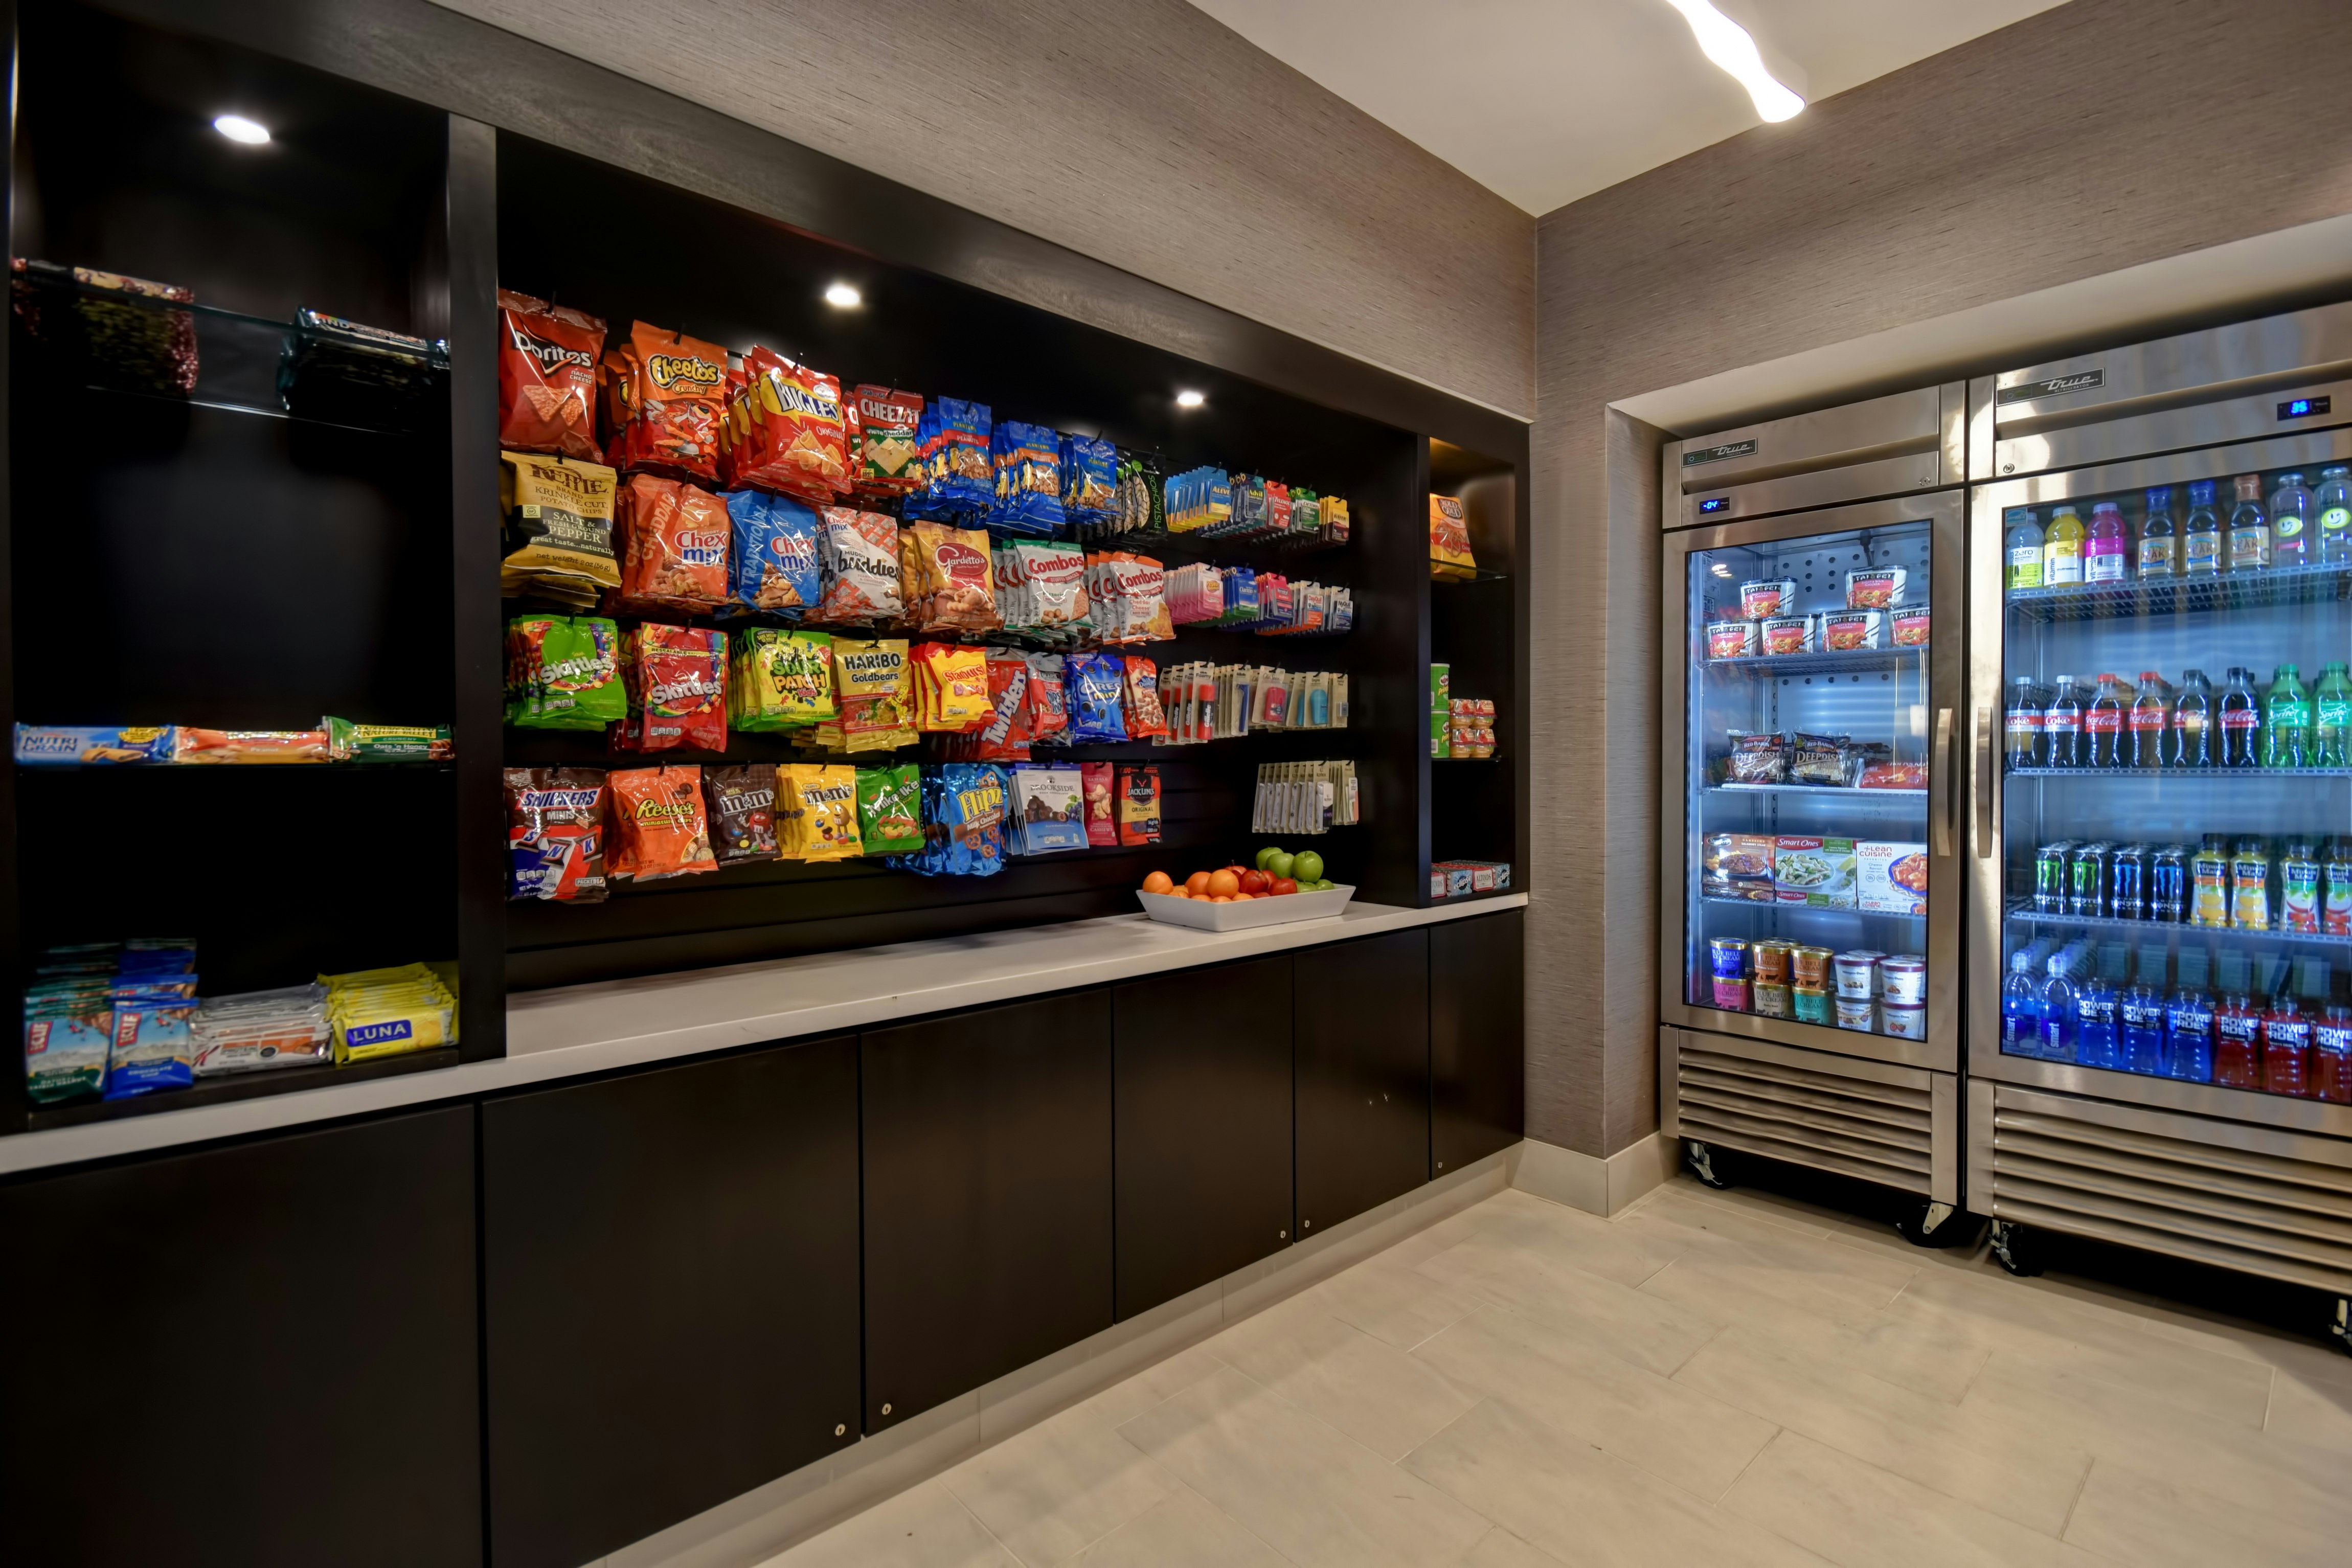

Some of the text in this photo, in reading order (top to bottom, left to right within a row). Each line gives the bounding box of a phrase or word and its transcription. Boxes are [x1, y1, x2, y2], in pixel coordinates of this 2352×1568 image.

[515, 331, 592, 367] Doritos
[571, 371, 592, 379] NACHO
[650, 355, 718, 387] Cheetos
[570, 375, 592, 384] CHEESE
[672, 384, 707, 394] Crunchy
[2054, 382, 2091, 393] REFRIGERATOR
[766, 374, 839, 422] BUGLES
[816, 426, 844, 440] ORIGINAL
[957, 435, 979, 444] PEANUTS
[535, 486, 582, 506] KRINKLE
[556, 485, 583, 499] BRAND
[1213, 486, 1230, 495] ALEVE
[1249, 489, 1263, 497] Advil
[541, 496, 574, 509] POTATO
[1148, 475, 1162, 529] PISTACHIOS
[1275, 497, 1290, 506] TYLENOL
[1440, 499, 1458, 508] ROLD
[553, 511, 584, 526] SALT
[1334, 513, 1347, 521] BAYER
[1441, 506, 1461, 517] GOLD
[543, 519, 606, 535] FRESH GROUND
[642, 493, 676, 560] CHEDDAR
[549, 526, 602, 543] PEPPER
[675, 530, 727, 548] Chex
[741, 504, 767, 585] TRADITIONAL
[771, 535, 815, 555] Chex
[552, 555, 579, 565] weight
[682, 547, 725, 566] mix
[781, 551, 817, 571] mix
[845, 551, 865, 559] MUDDY
[935, 546, 985, 576] Gardetto's
[838, 551, 899, 582] buddies
[1028, 555, 1083, 574] Combos
[1066, 572, 1079, 581] SNACKS
[1118, 569, 1163, 589] Combos
[773, 660, 821, 675] SOUR
[844, 653, 901, 670] HARIBO
[540, 656, 614, 685] Skittles
[773, 673, 826, 692] PATCH
[852, 673, 899, 683] Goldbears
[652, 680, 722, 705] Skittles
[797, 689, 818, 697] Kids
[1080, 683, 1121, 695] OREO
[2046, 716, 2070, 724] Coke
[2320, 709, 2347, 719] Sprite
[363, 729, 435, 738] NATURE VALLEY
[22, 744, 77, 752] GRAIN
[25, 737, 78, 745] NUTRI
[523, 790, 597, 806] SNICKERS
[636, 799, 695, 820] Reese's
[959, 788, 1003, 823] Flipz
[967, 820, 980, 831] Milk
[525, 831, 536, 841] S
[549, 846, 561, 857] N
[585, 839, 592, 852] K
[1454, 875, 1472, 890] eclipse
[2078, 1000, 2114, 1011] POWER
[2123, 1005, 2161, 1016] POWER
[353, 1025, 407, 1041] LUNA
[2006, 1017, 2016, 1041] smart
[2268, 1021, 2308, 1033] POWER
[2049, 1022, 2060, 1048] smart
